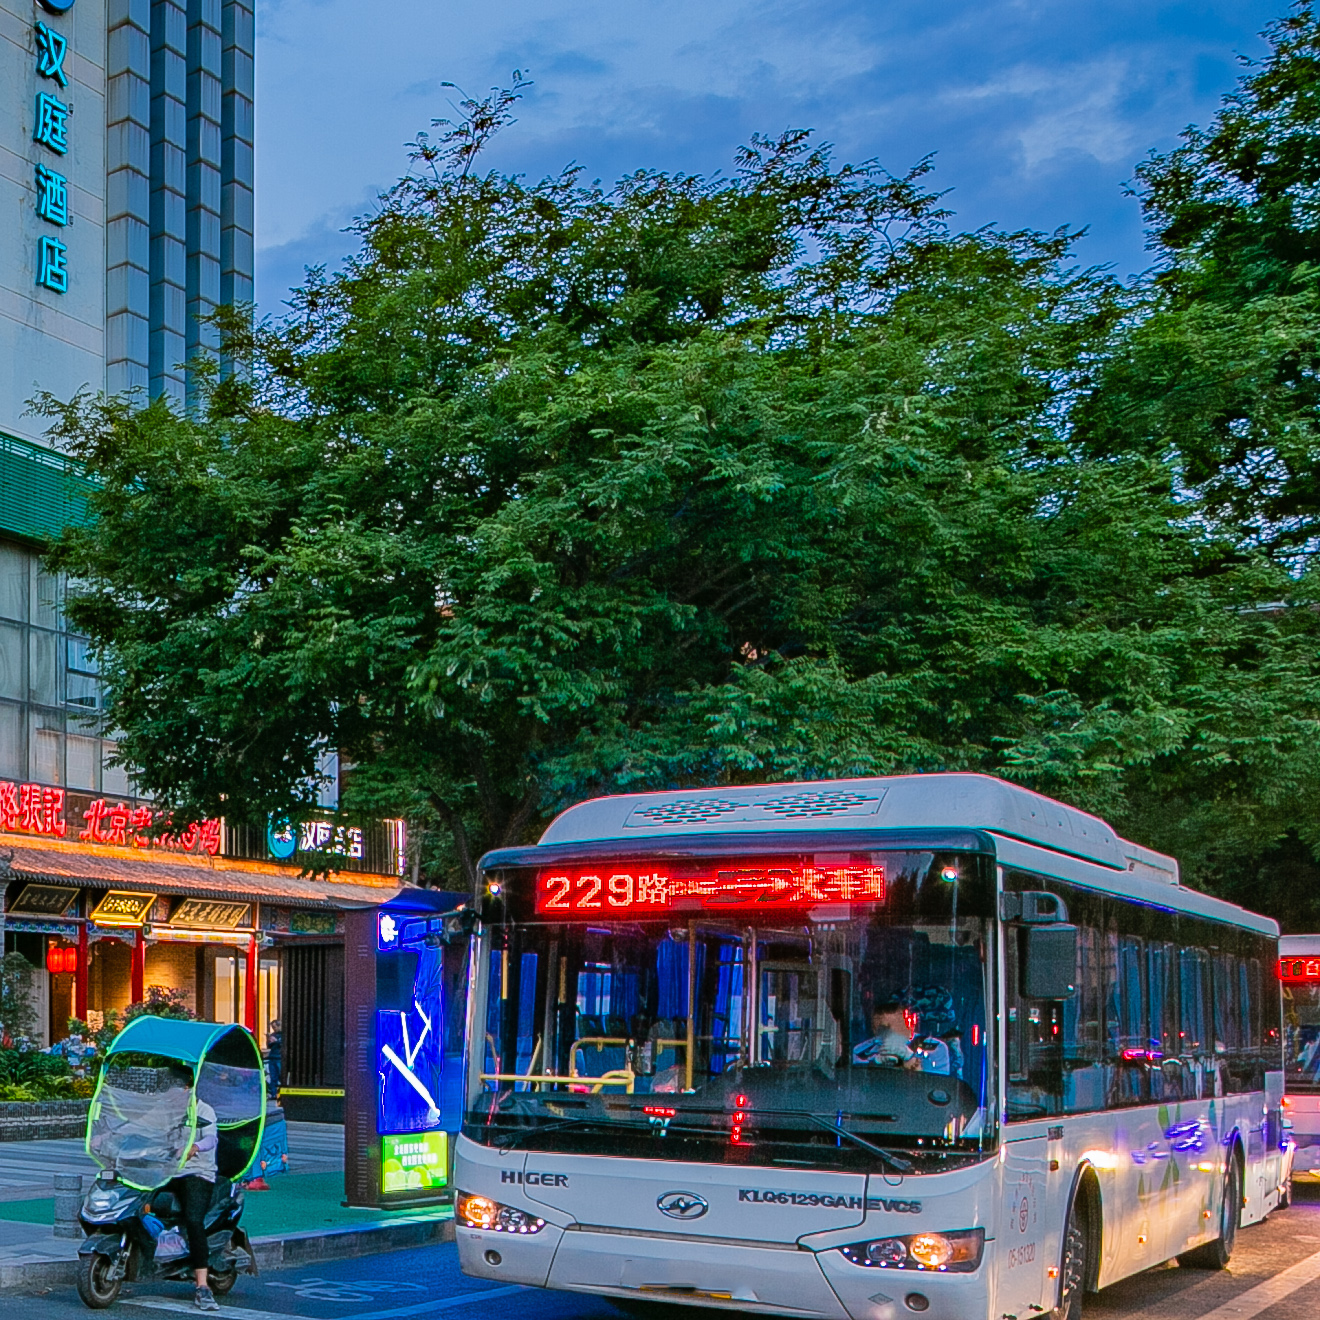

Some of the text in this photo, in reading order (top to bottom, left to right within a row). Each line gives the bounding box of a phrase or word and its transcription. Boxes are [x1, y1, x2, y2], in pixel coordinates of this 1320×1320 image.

[34, 21, 68, 294] 汉庭酒店
[501, 1170, 569, 1188] HIGER
[738, 1189, 922, 1214] KLQ6129GAHEVC5
